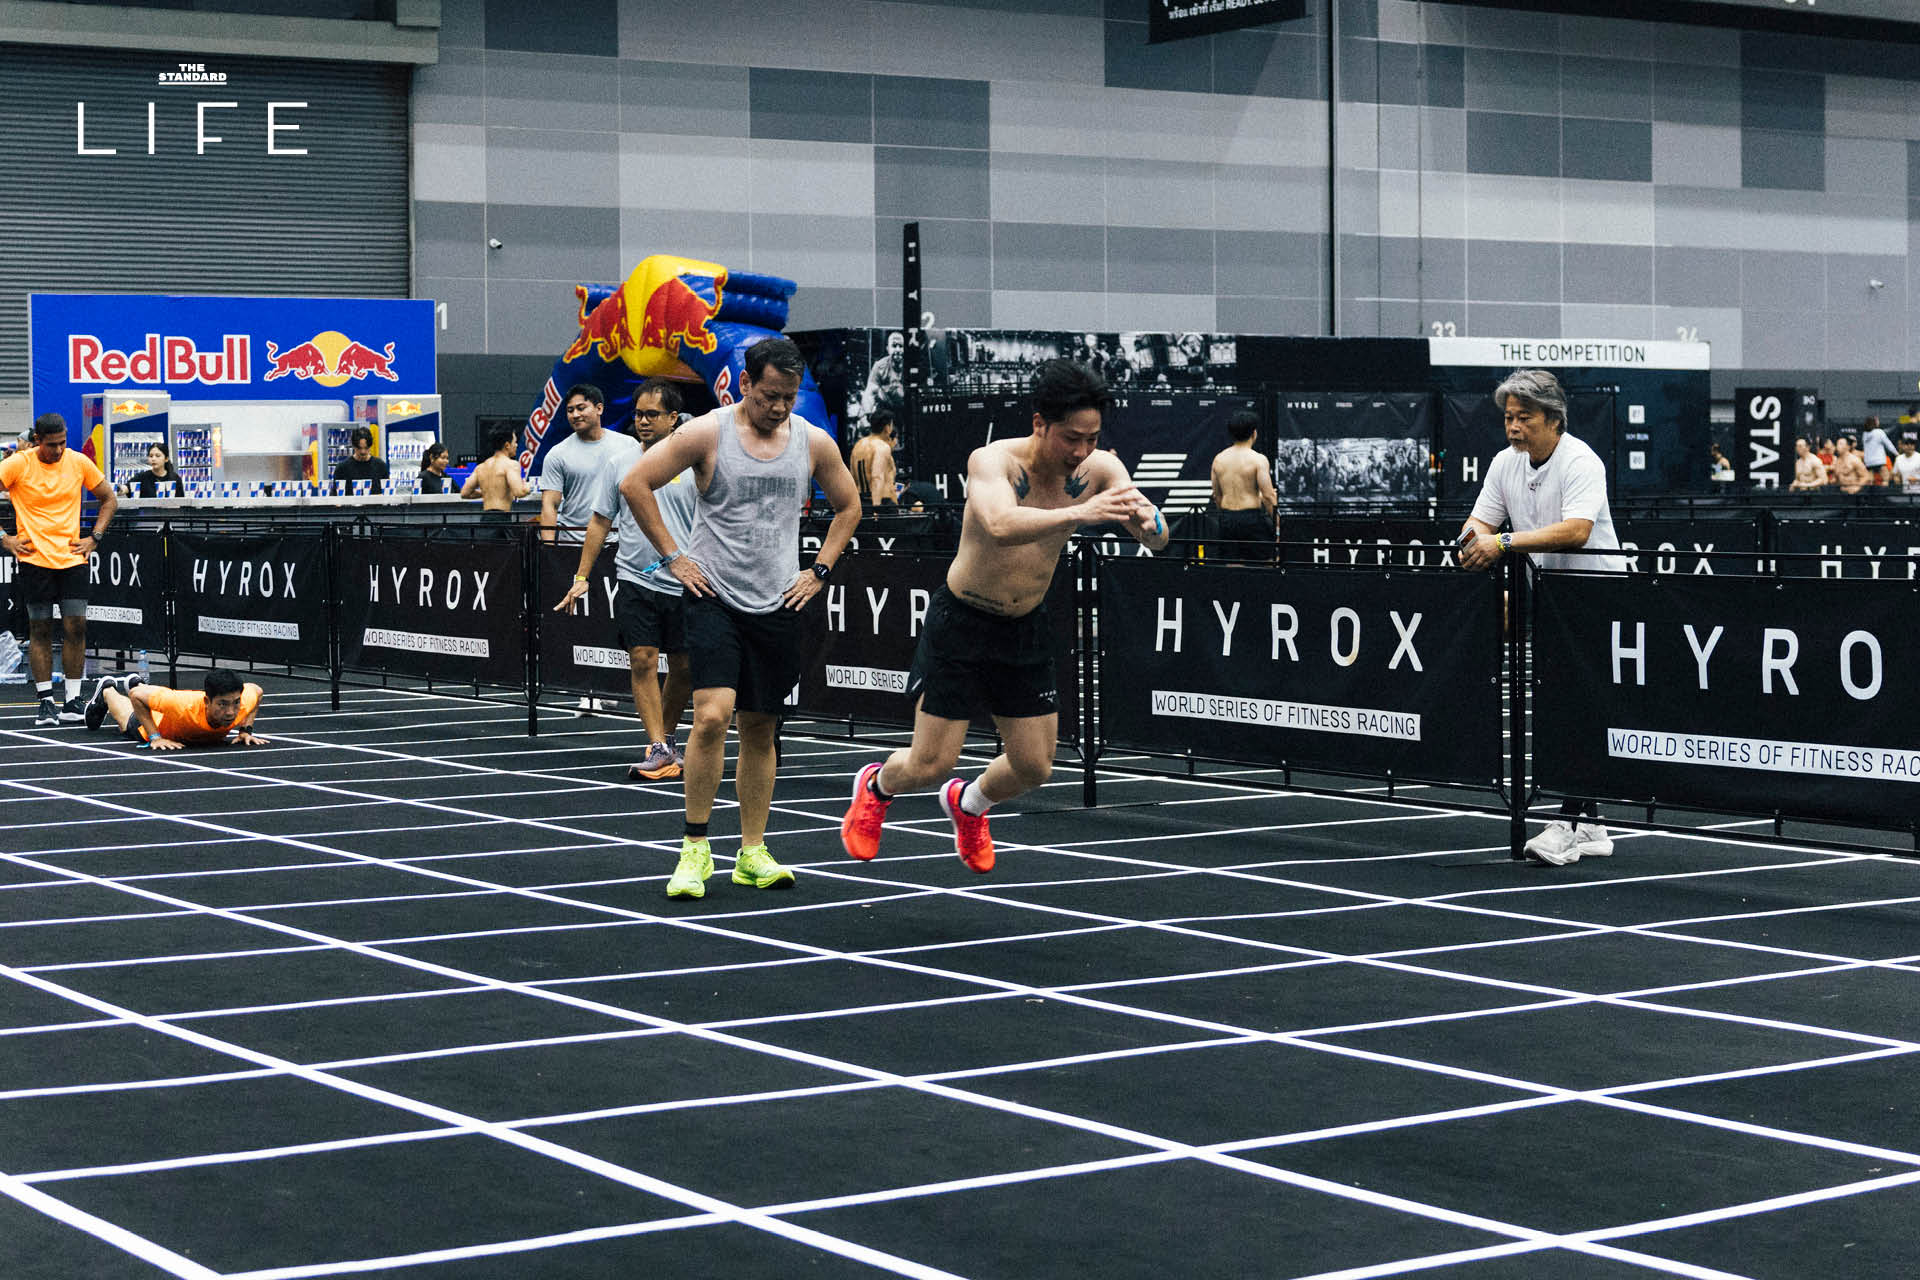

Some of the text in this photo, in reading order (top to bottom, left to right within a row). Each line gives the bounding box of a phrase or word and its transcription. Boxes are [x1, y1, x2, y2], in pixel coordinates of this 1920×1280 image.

[68, 333, 251, 385] Red Bull
[1500, 343, 1646, 363] THE COMPETITION
[192, 558, 297, 599] HYROX
[369, 564, 490, 611] HYROX
[364, 631, 487, 655] WORLD SERIES OF FITNESS RACING
[1155, 597, 1424, 672] HYROX
[574, 647, 605, 664] WORLD
[1611, 620, 1883, 700] HYRO
[827, 668, 904, 690] WORLD SERIES
[1155, 694, 1416, 736] WORLD SERIES OF FITNESS RACING
[1611, 733, 1677, 757] WORLD
[1684, 738, 1751, 763] SERIES
[1758, 744, 1783, 765] OF
[1790, 747, 1873, 773] FITNESS
